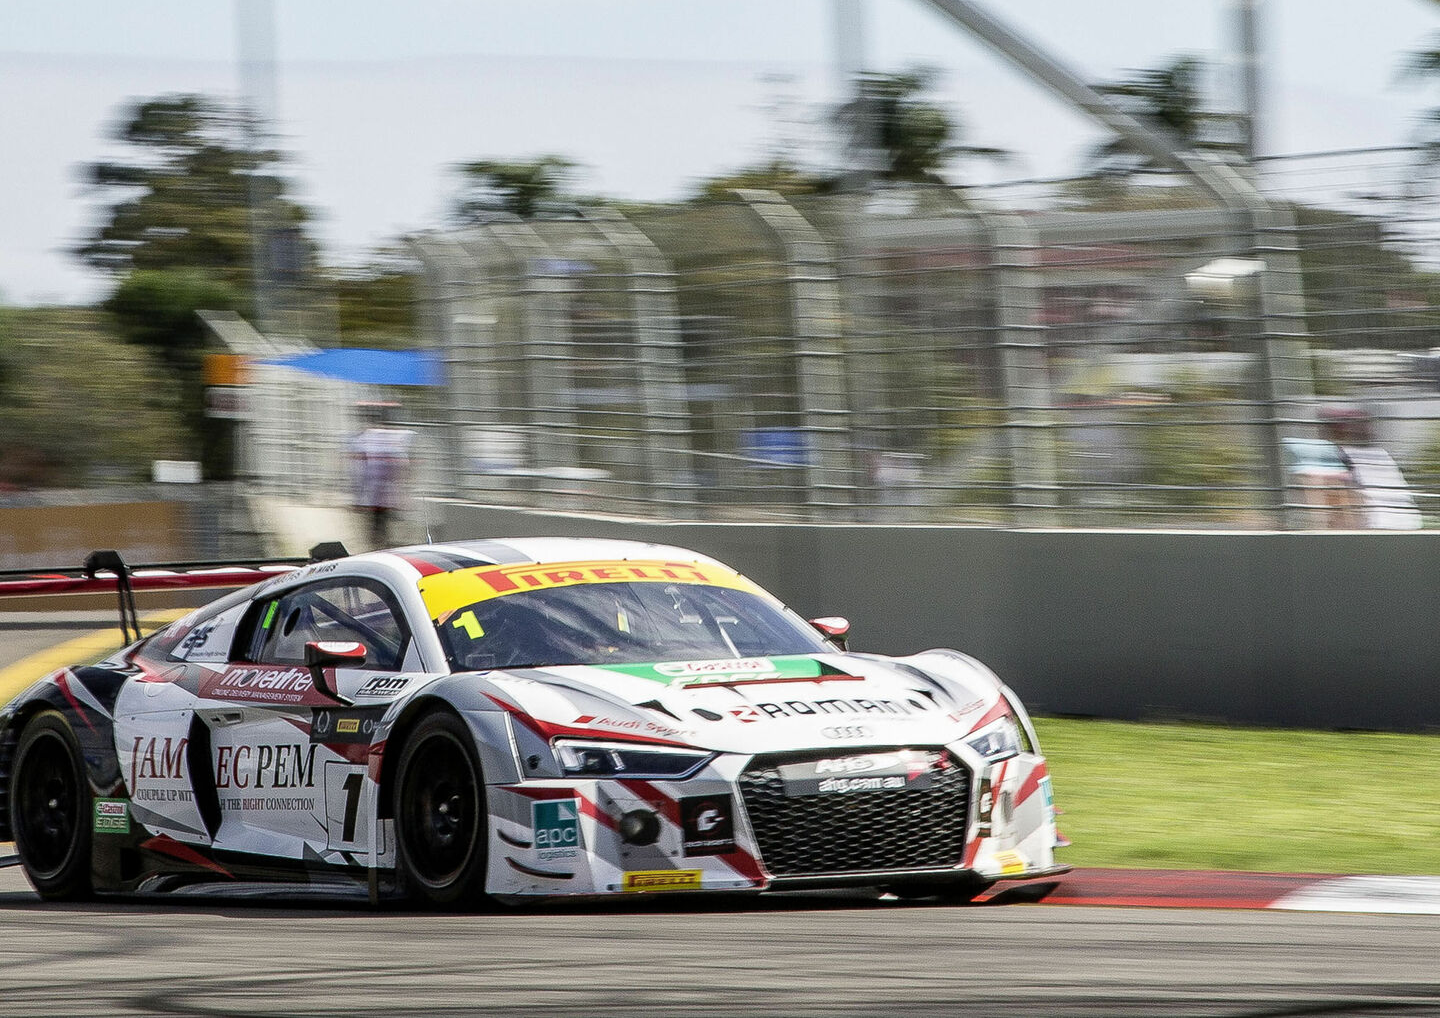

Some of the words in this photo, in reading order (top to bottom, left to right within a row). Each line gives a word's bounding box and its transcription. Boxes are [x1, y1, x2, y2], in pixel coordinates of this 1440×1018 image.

[476, 560, 711, 593] PIRELLI
[452, 610, 485, 640] 1
[364, 677, 409, 691] rpm
[597, 717, 640, 729] Audi
[644, 722, 696, 737] Sport
[254, 744, 318, 789] PEM
[137, 788, 166, 801] COUPLE
[167, 789, 177, 801] UP
[227, 799, 241, 810] THE
[243, 799, 265, 810] RIGHT
[266, 798, 314, 811] CONNECTION
[342, 773, 364, 842] 1
[536, 828, 577, 848] apc
